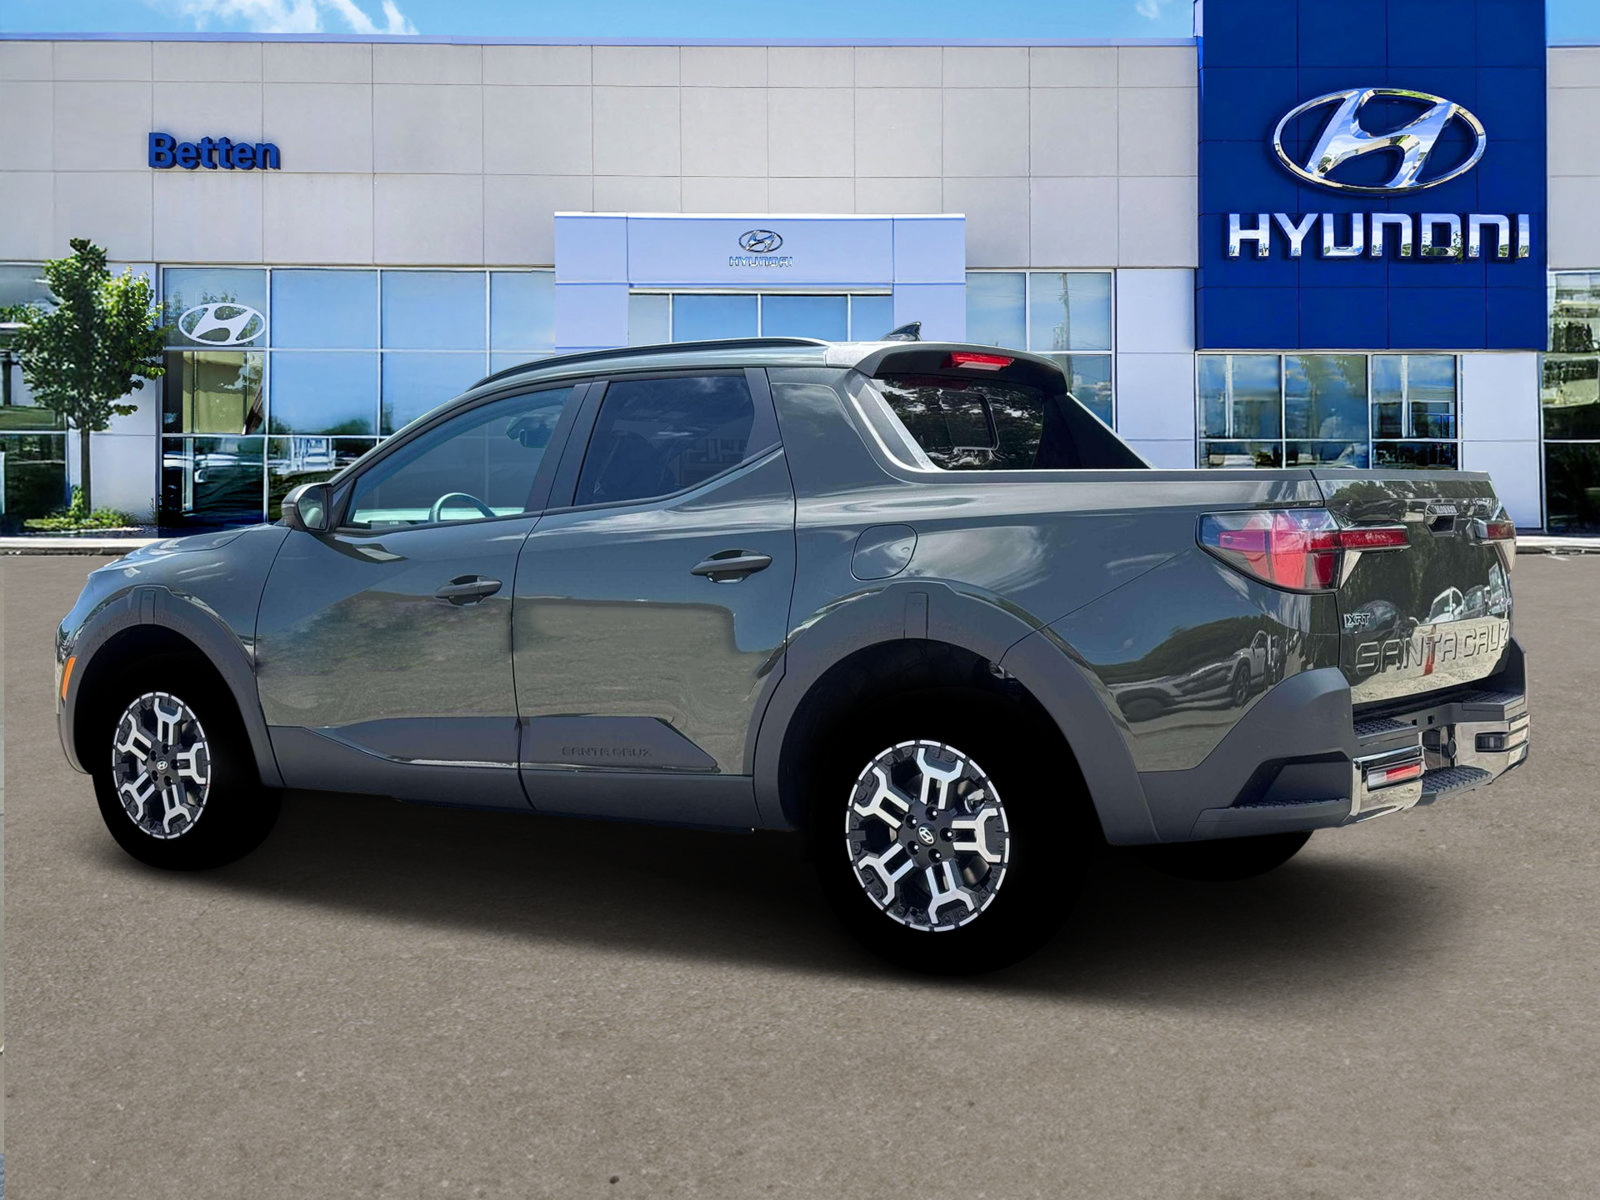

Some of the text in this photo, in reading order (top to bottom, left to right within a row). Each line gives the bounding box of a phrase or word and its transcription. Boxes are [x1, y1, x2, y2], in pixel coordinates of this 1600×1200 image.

[148, 132, 281, 170] Betten
[1229, 212, 1530, 258] HYUNDAI
[728, 256, 793, 267] HYUNDAI
[1355, 632, 1458, 675] SANTA
